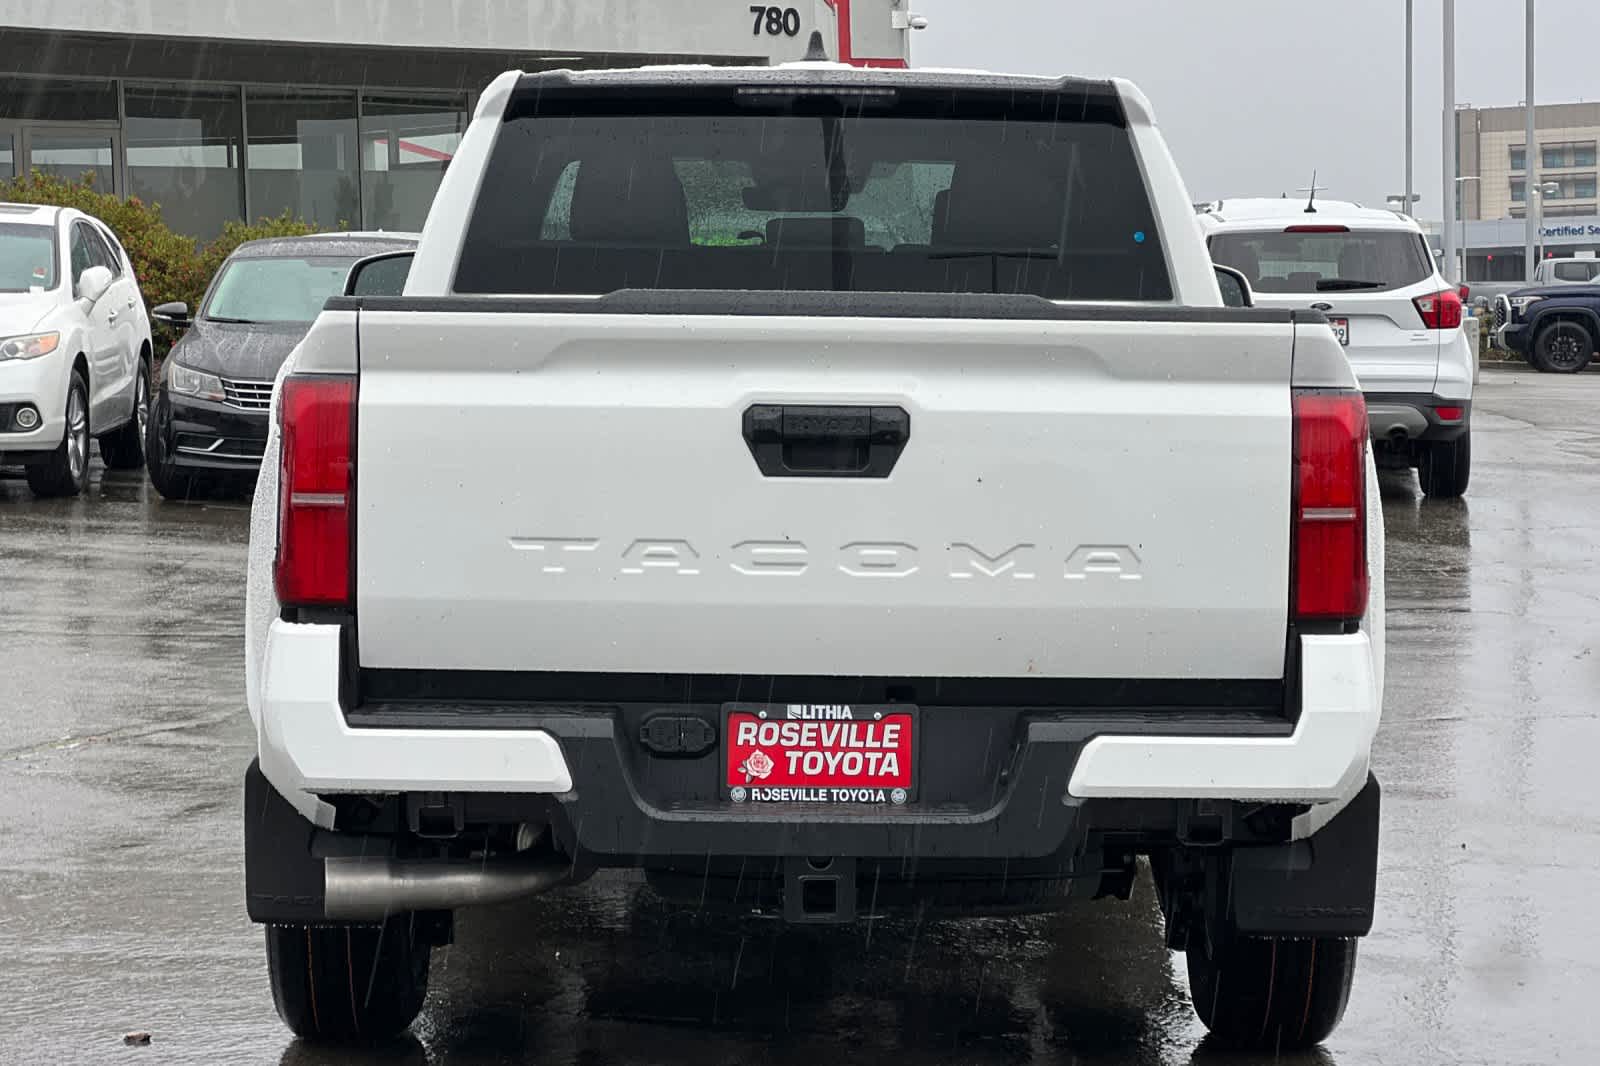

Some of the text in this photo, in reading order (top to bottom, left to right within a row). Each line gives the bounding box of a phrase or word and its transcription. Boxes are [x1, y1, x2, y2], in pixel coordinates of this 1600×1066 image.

[750, 6, 800, 36] 780
[1538, 225, 1584, 237] Certified
[507, 536, 1143, 580] TACOMA
[802, 704, 853, 720] LITHIA
[737, 721, 901, 748] ROSEVILLE
[785, 751, 900, 777] TOYOTA
[751, 788, 886, 803] ROSEVILLE TOYOTA
